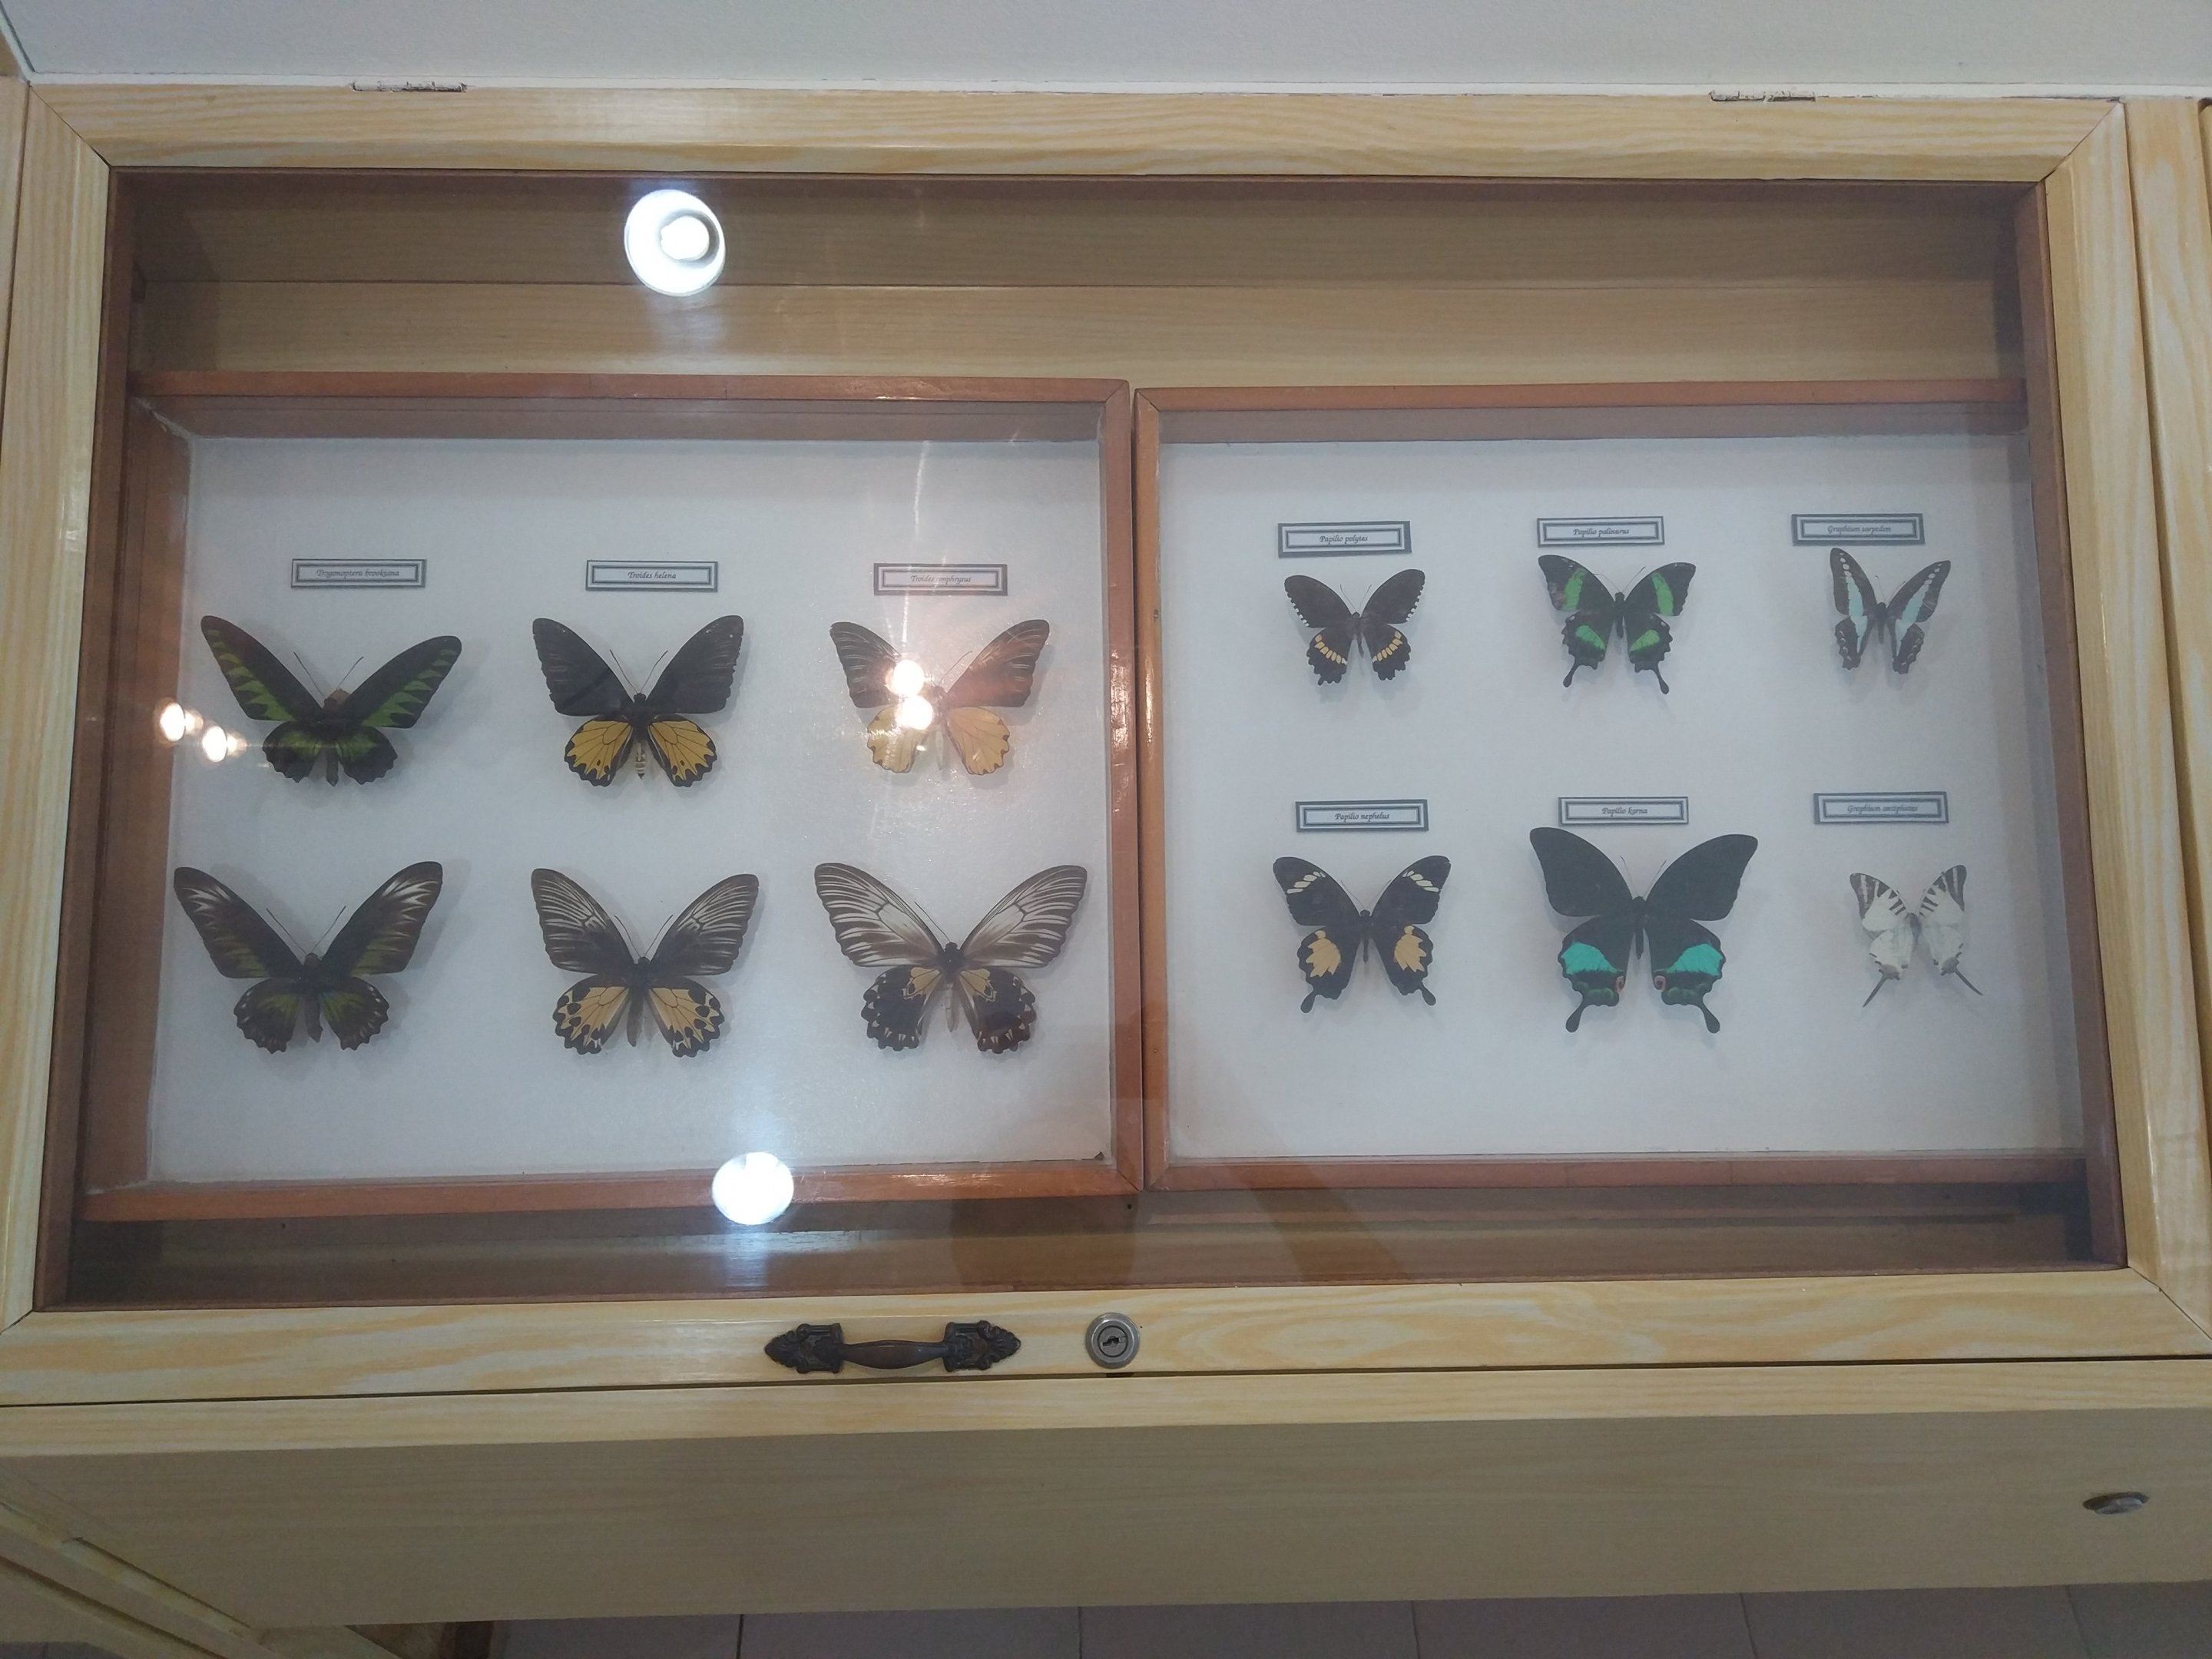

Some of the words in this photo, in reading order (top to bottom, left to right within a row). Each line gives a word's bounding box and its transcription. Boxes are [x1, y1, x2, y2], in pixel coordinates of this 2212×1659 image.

[1573, 528, 1598, 538] Papilio
[1320, 535, 1343, 545] Papilio
[1344, 534, 1369, 545] polytes
[1335, 812, 1359, 823] Papilio
[1360, 811, 1390, 822] nephelus
